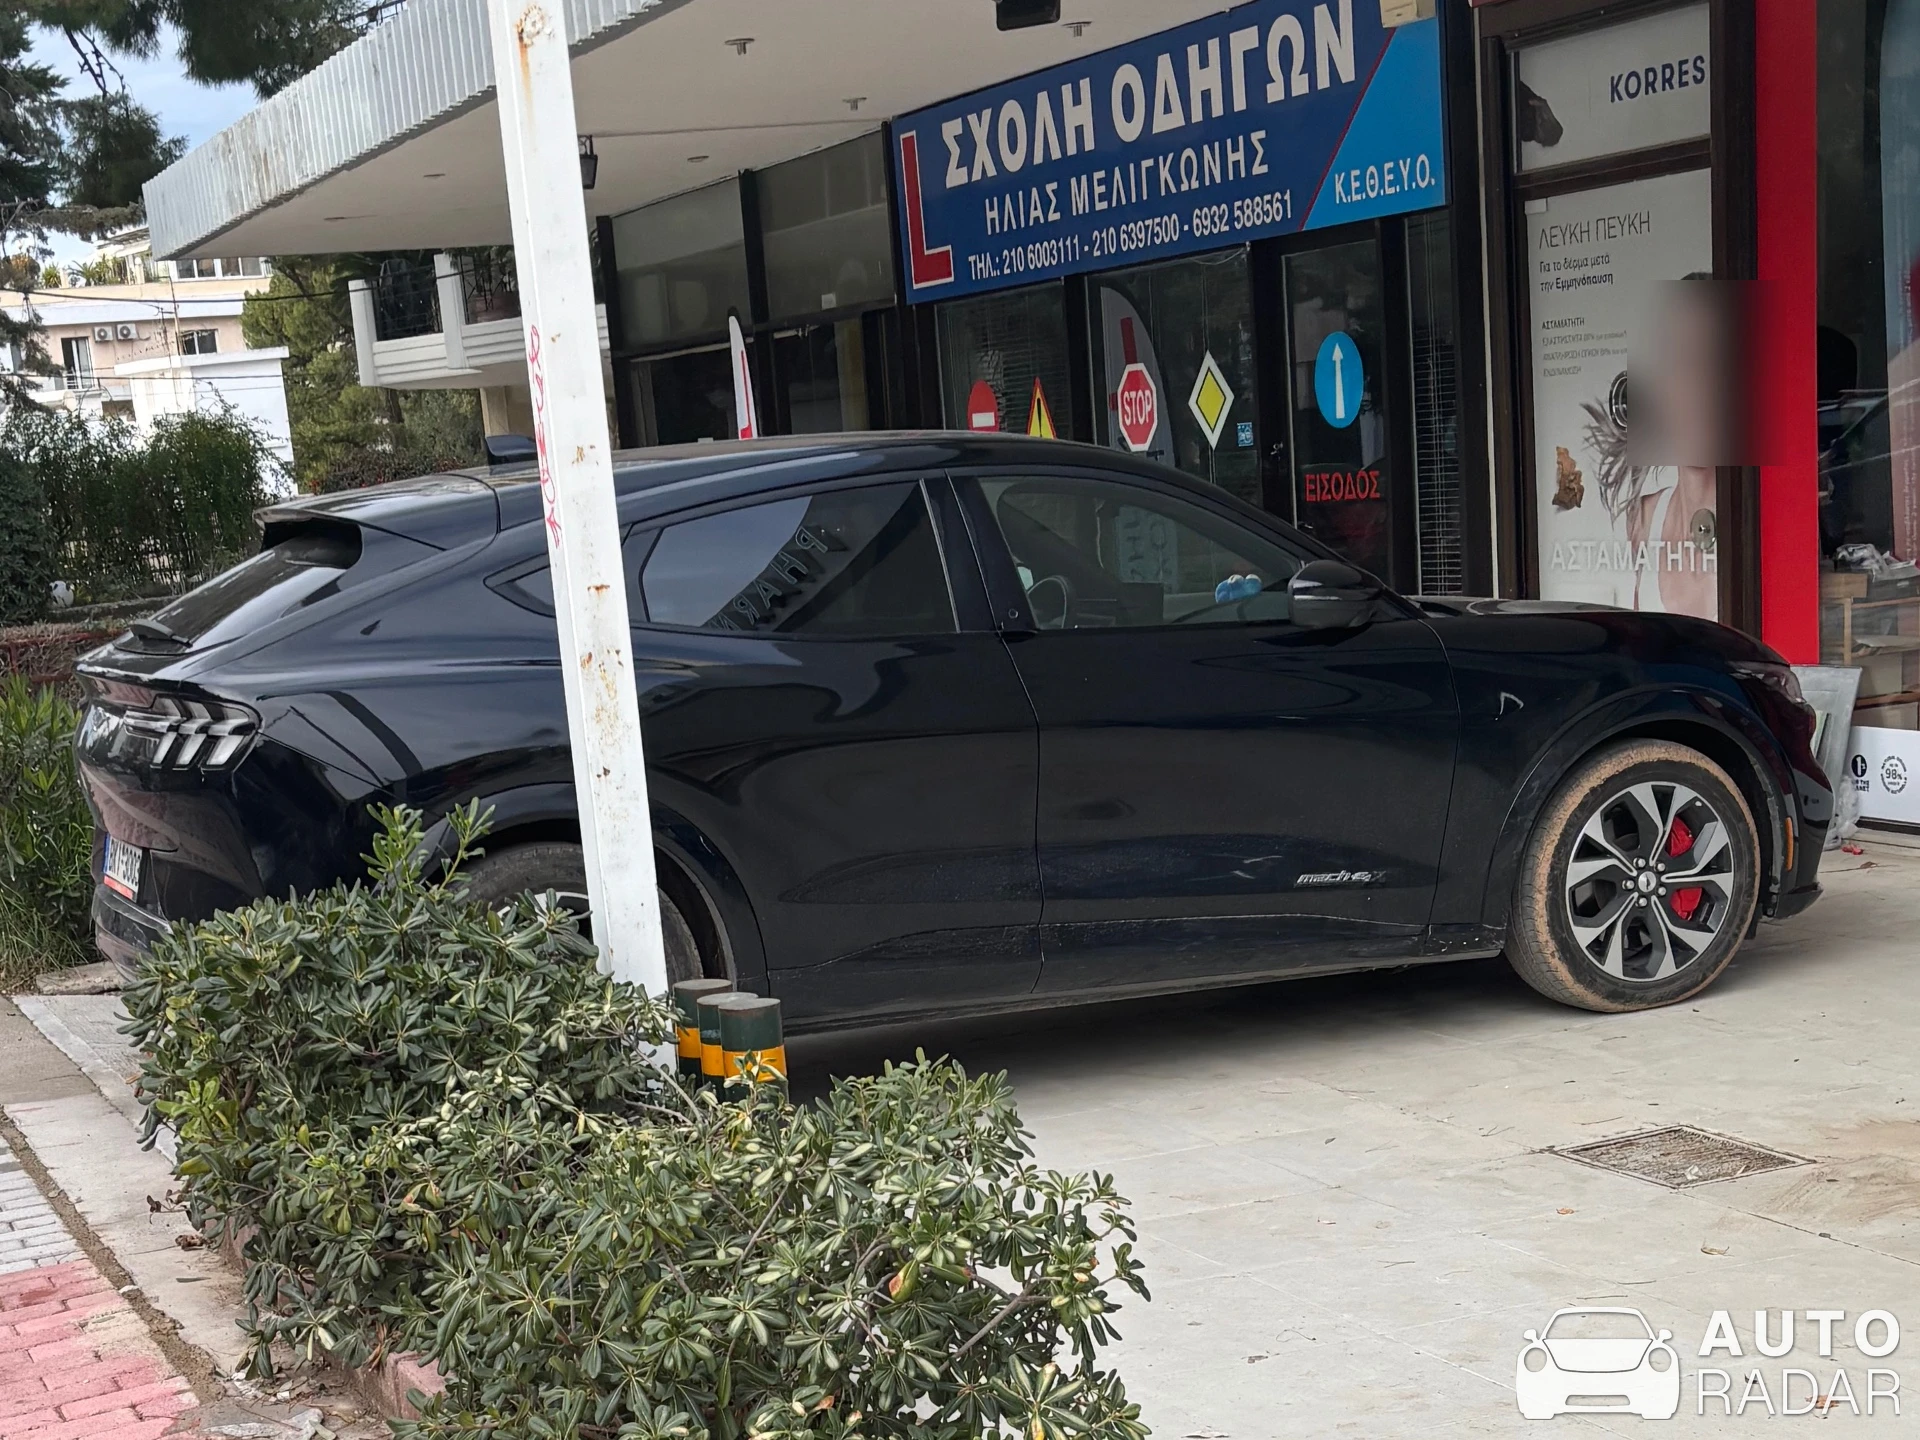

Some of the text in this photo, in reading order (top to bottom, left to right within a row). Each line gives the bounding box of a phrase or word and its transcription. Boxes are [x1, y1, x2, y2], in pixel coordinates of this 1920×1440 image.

[941, 0, 1356, 189] ΣΧΟΛΗ ΟΔΗΓΩΝ
[1609, 55, 1706, 103] KORRES
[985, 129, 1269, 236] ΗΛΙΑΣ ΜΕΛΙΓΚΩΝΗΣ
[1334, 153, 1436, 205] Κ.Ε.Θ.Ε.Υ.Ο.
[968, 252, 1000, 281] ΤΗΛ.:
[1002, 245, 1025, 275] 210
[1027, 233, 1080, 271] 6003111
[1093, 226, 1116, 257] 210
[1120, 213, 1179, 252] 6397500
[1193, 203, 1230, 237] 6932
[1234, 189, 1292, 230] 588561
[1539, 210, 1651, 249] ΛΕΥΚΗ ΠΕΥΚΗ
[1123, 389, 1152, 426] STOP
[1305, 469, 1381, 502] ΕΙΣΟΔΟΣ
[1551, 541, 1718, 572] ΑΣΤΑΜΑΤΗΤΗ
